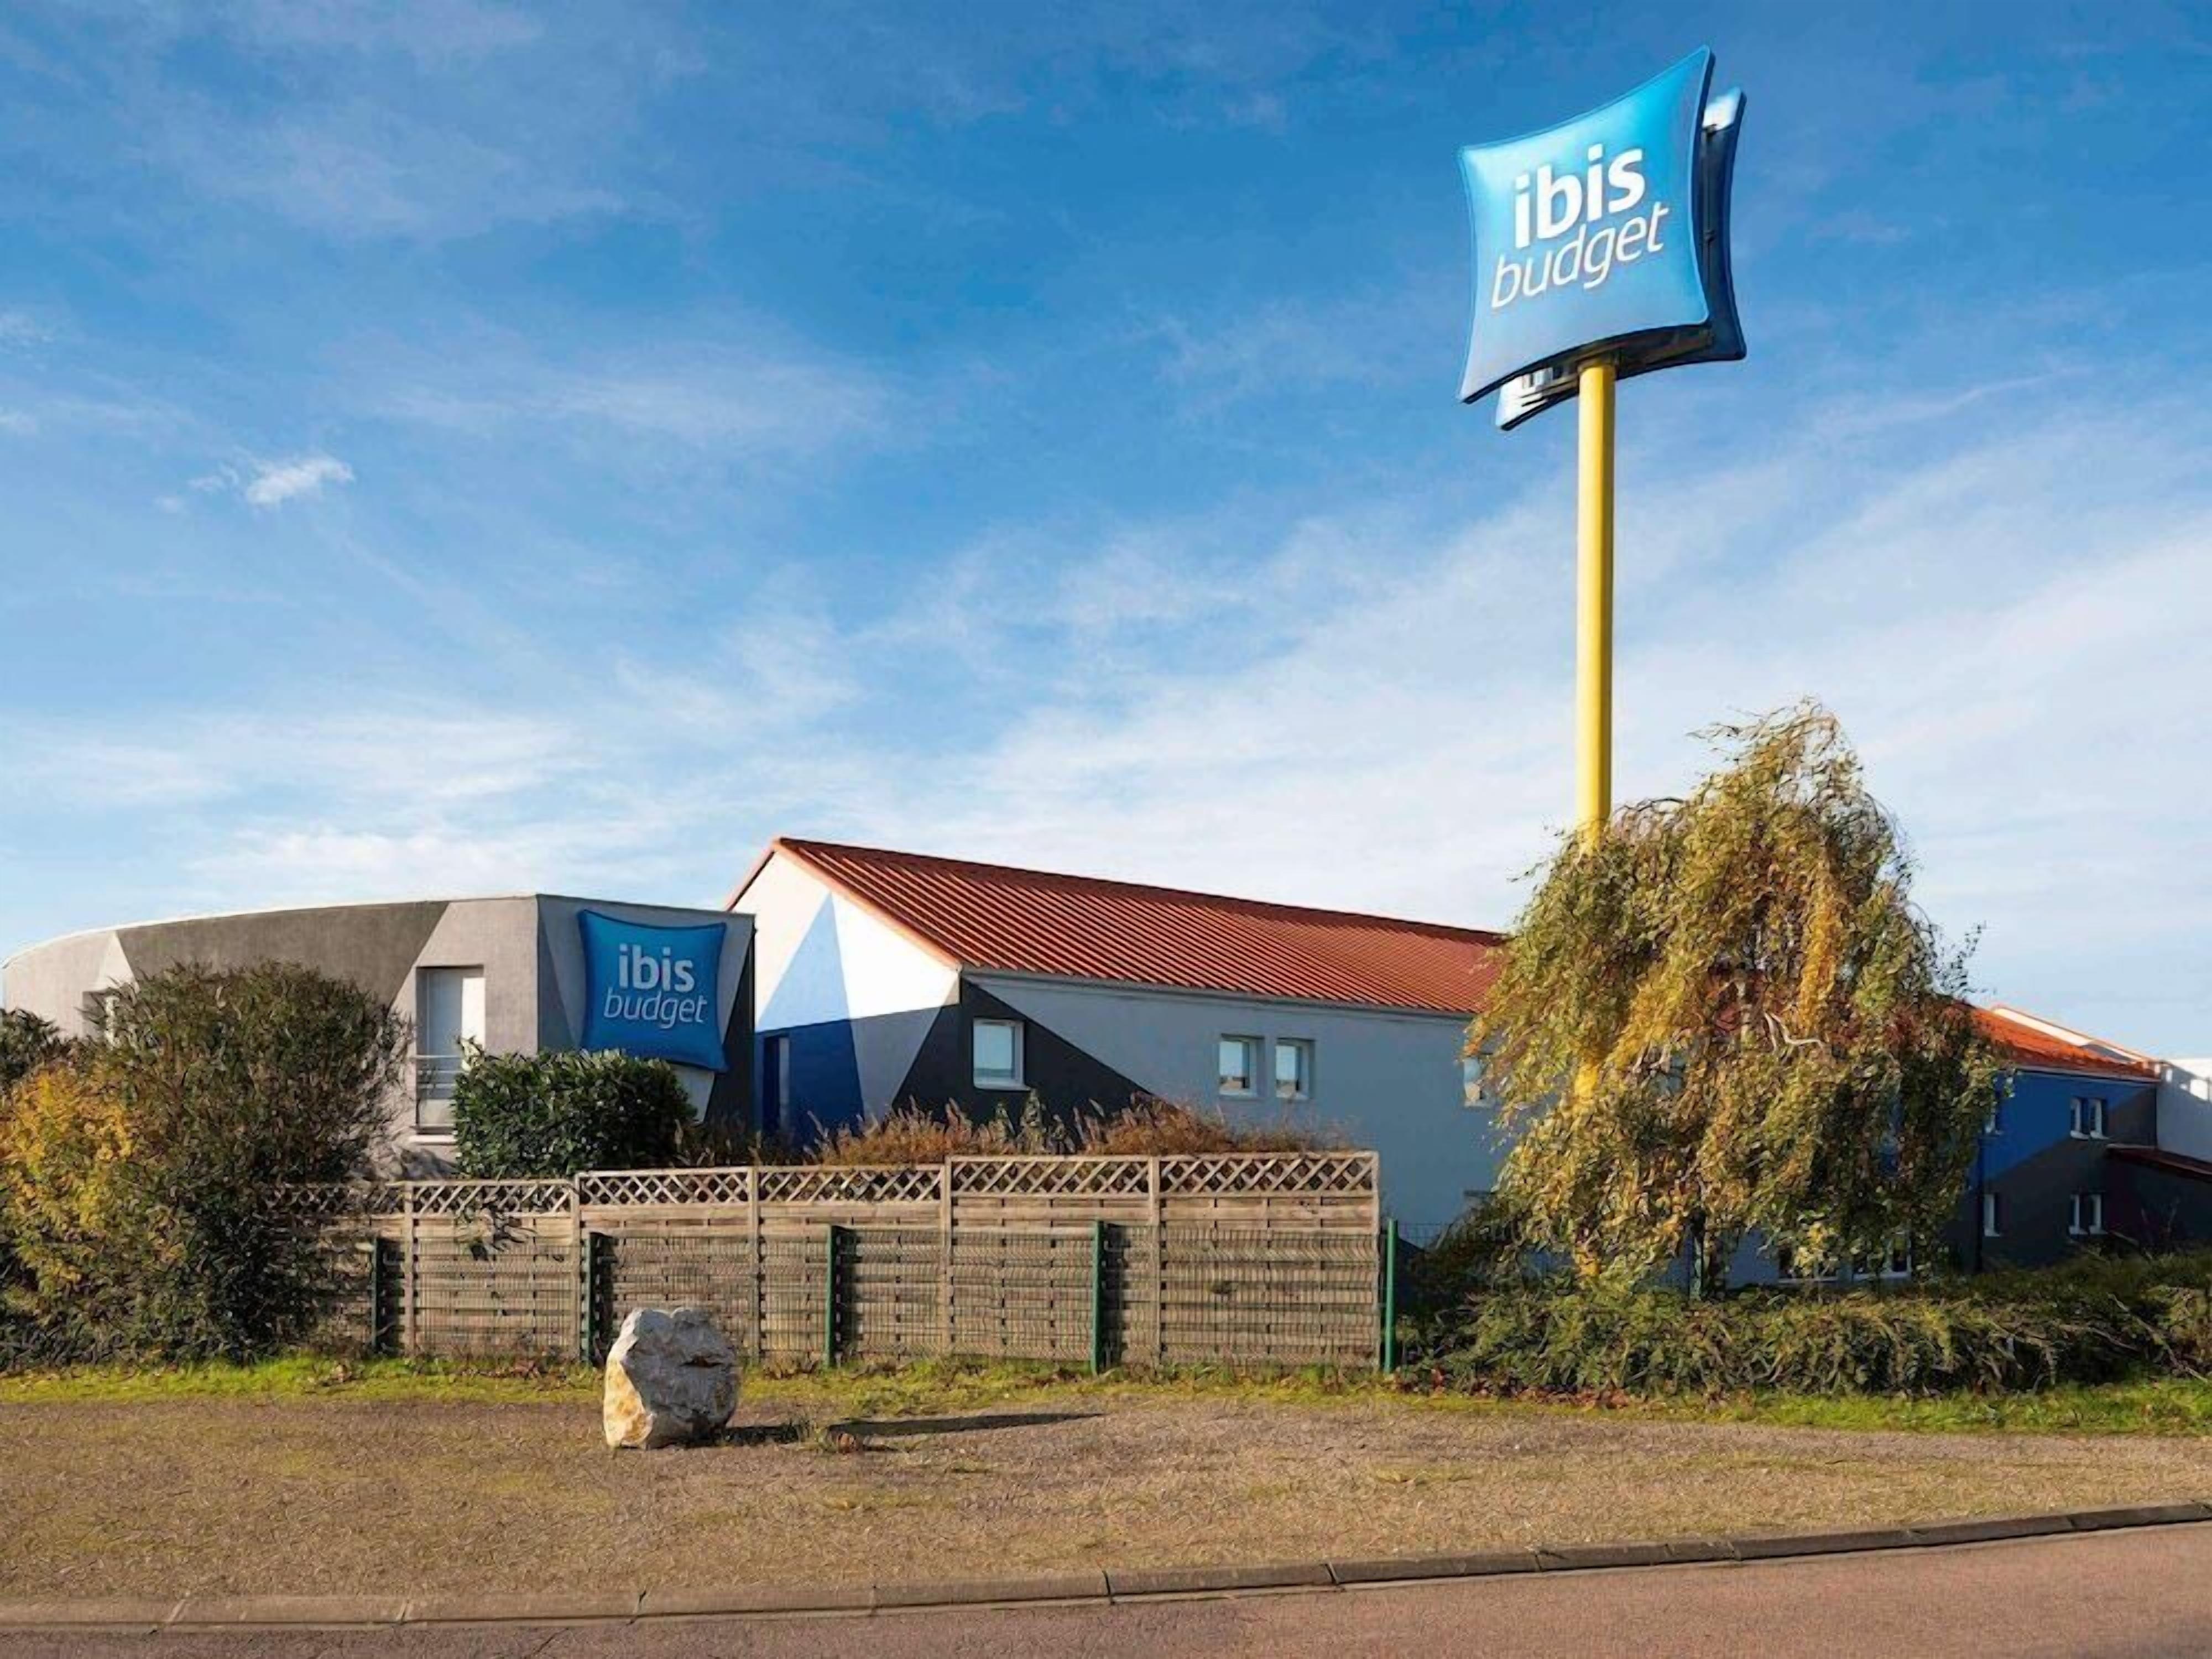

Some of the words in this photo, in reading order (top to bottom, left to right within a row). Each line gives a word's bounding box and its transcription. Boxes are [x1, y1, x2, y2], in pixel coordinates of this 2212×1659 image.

[1514, 143, 1646, 248] ibis
[1492, 201, 1668, 308] budget
[619, 943, 695, 992] ibis
[604, 987, 707, 1029] budget
